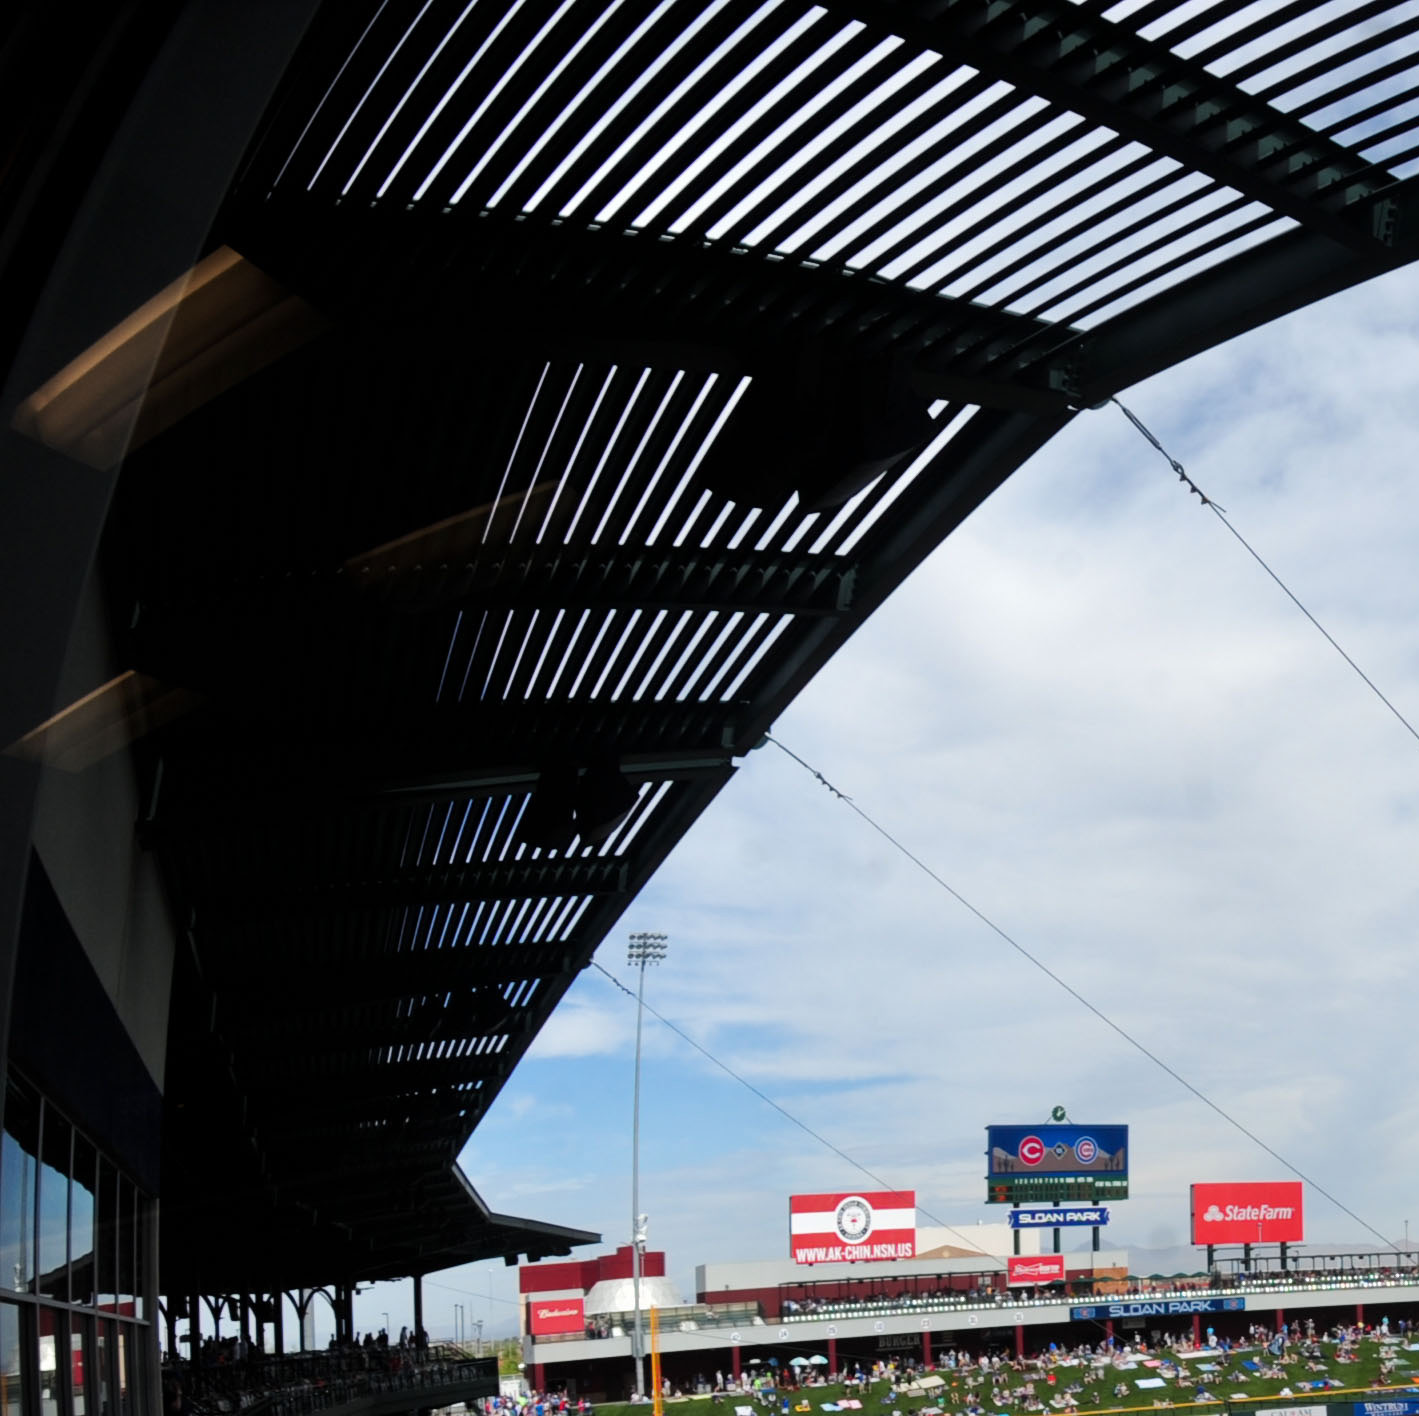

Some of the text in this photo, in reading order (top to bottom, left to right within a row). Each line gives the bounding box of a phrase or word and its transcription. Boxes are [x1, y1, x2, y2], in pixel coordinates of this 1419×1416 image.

[1018, 1211, 1100, 1223] SLOAN PARK
[796, 1242, 912, 1263] WWW.AK-CHIN.NSN.US
[1109, 1300, 1216, 1318] SLOAN PARK
[878, 1335, 921, 1347] BURGER
